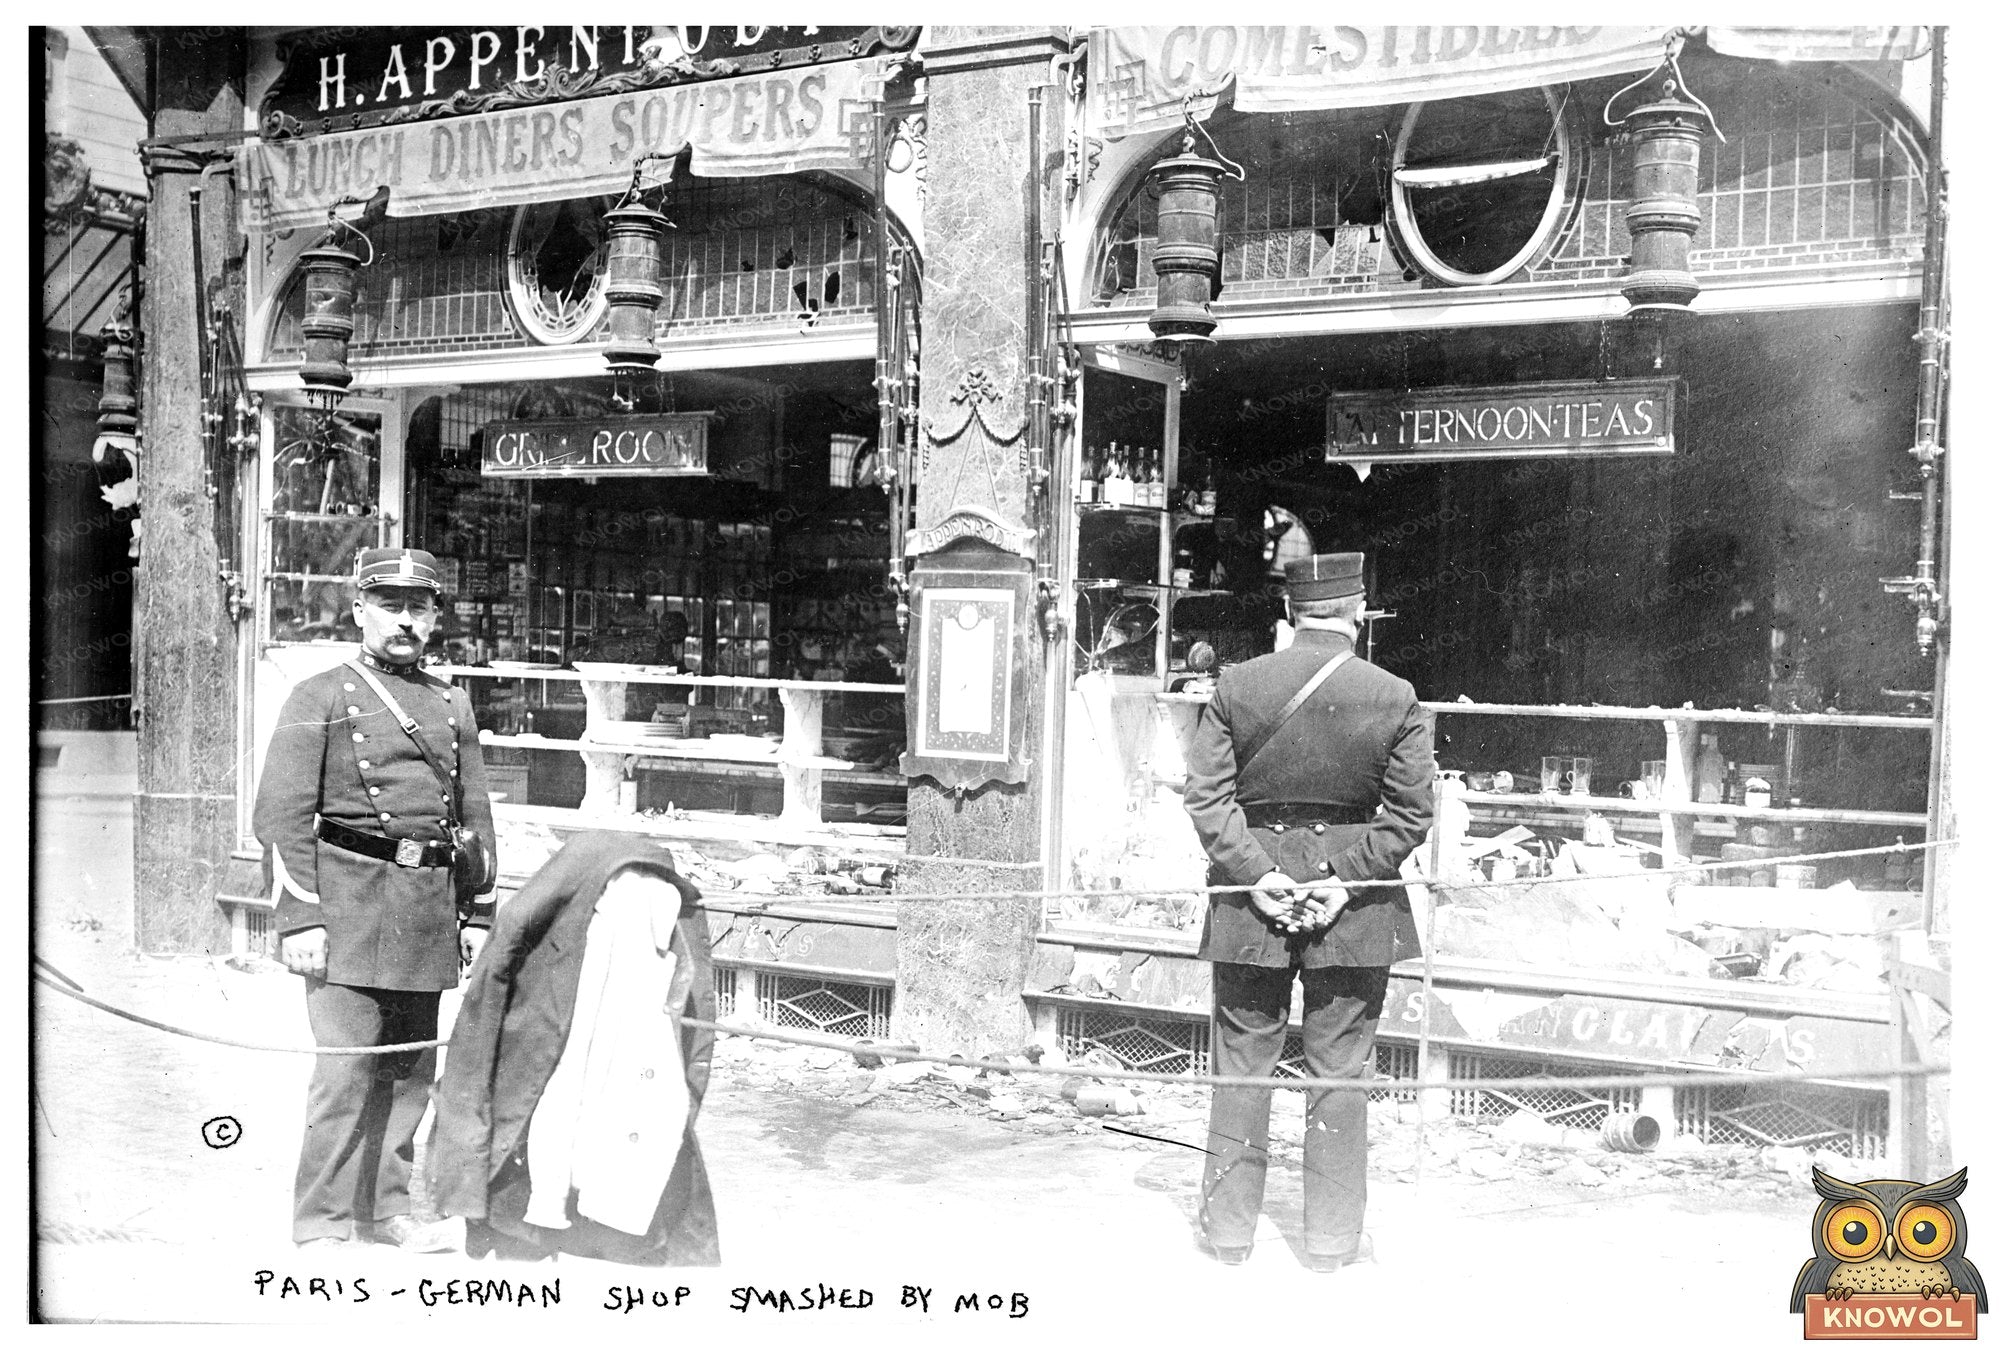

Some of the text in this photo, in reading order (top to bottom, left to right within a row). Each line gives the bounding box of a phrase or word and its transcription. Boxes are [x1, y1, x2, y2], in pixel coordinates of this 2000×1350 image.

[285, 74, 826, 200] LUNCH DINERS SOUPERS
